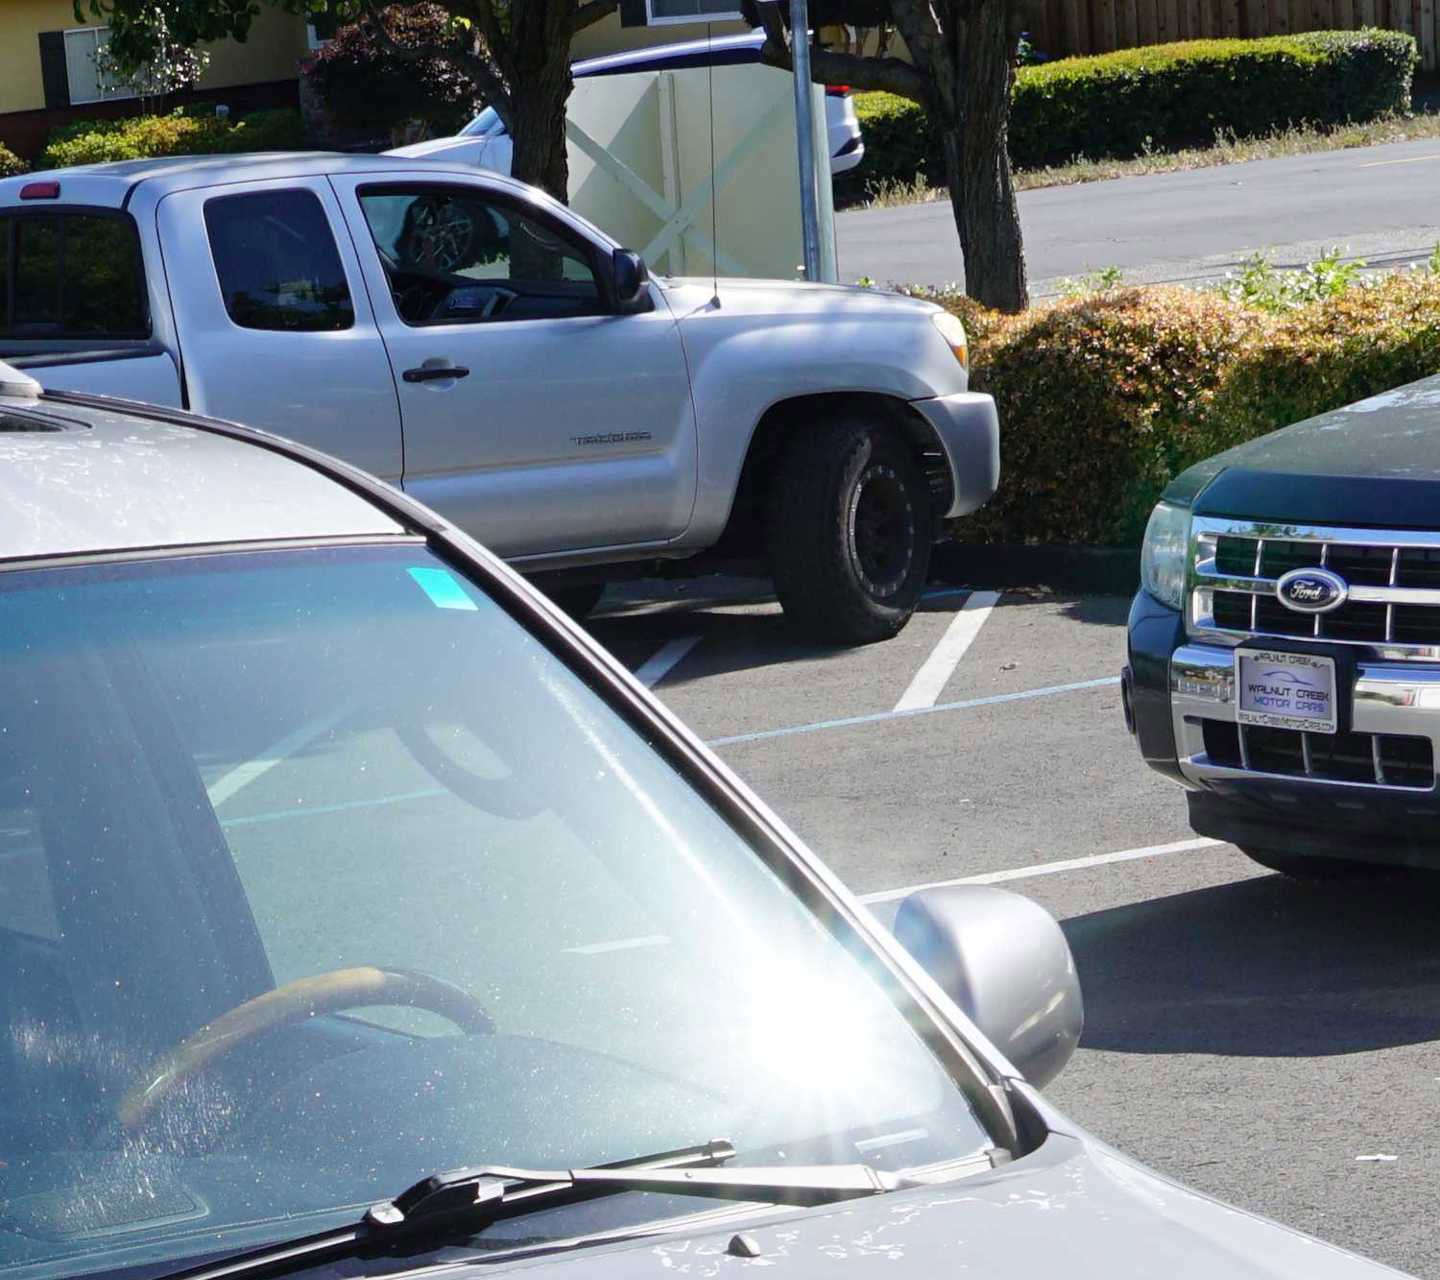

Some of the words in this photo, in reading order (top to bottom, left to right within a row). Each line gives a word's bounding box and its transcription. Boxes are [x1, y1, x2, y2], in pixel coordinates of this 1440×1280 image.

[1289, 579, 1322, 600] Ford
[1248, 682, 1291, 697] WALNUT
[1295, 687, 1329, 700] CREEK
[1254, 696, 1290, 709] MOTOR
[1295, 699, 1326, 712] CARS
